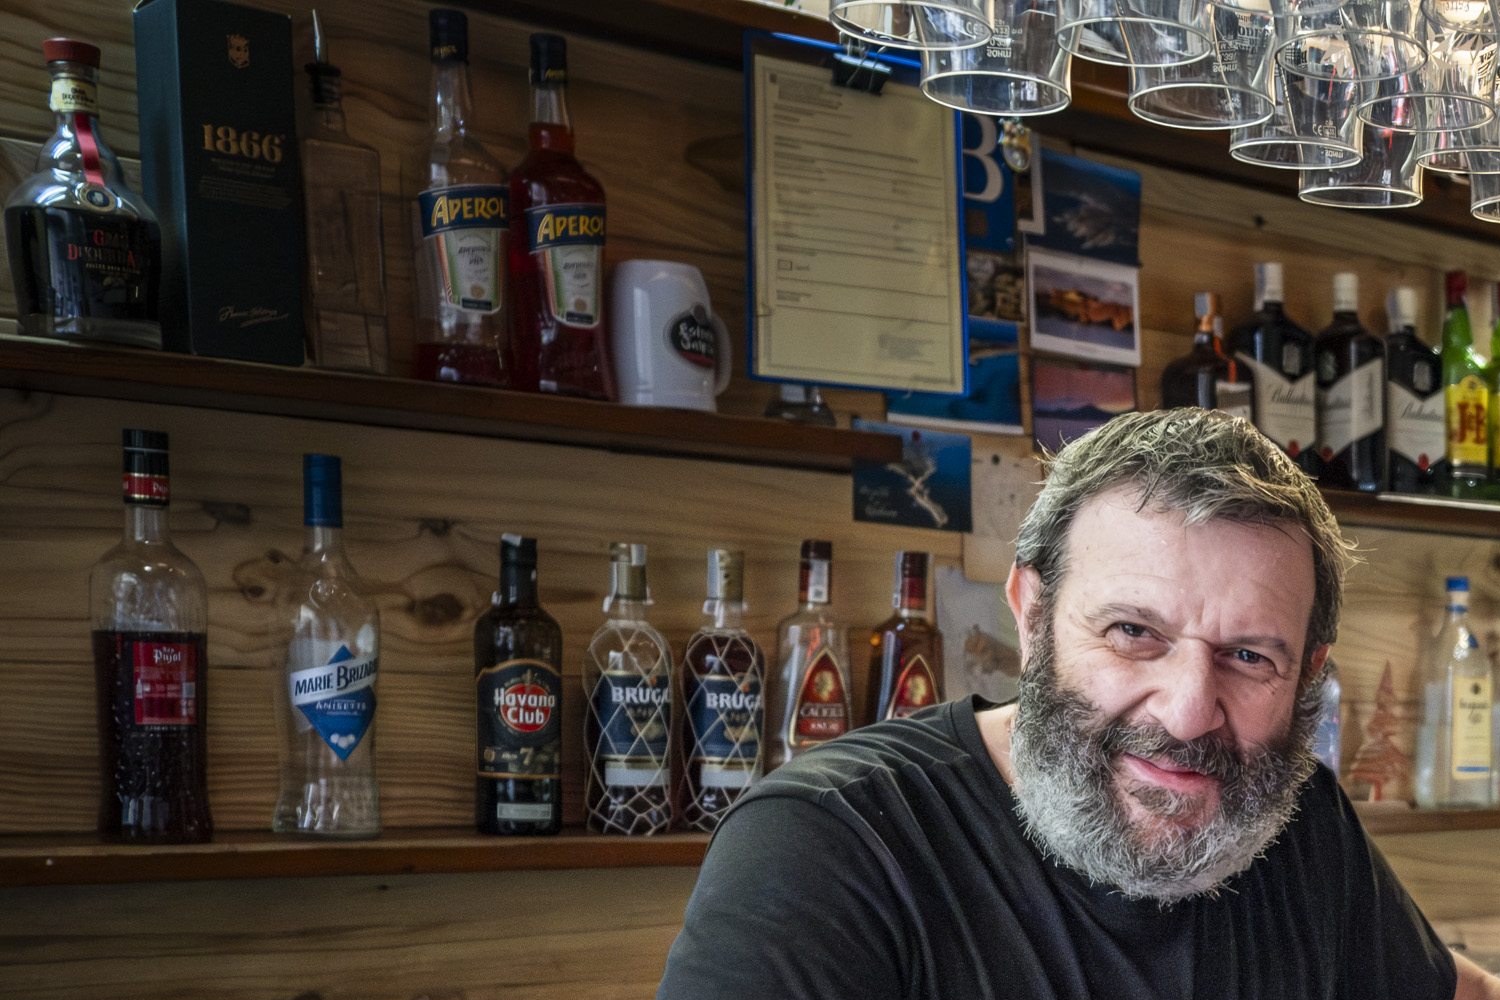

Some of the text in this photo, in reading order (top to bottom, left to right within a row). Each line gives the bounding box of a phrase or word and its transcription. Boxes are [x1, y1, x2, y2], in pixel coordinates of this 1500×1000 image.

[202, 123, 284, 164] 1866
[431, 196, 507, 227] APEROL
[295, 673, 333, 696] MARIE
[494, 687, 556, 707] Havana
[507, 707, 545, 724] Club
